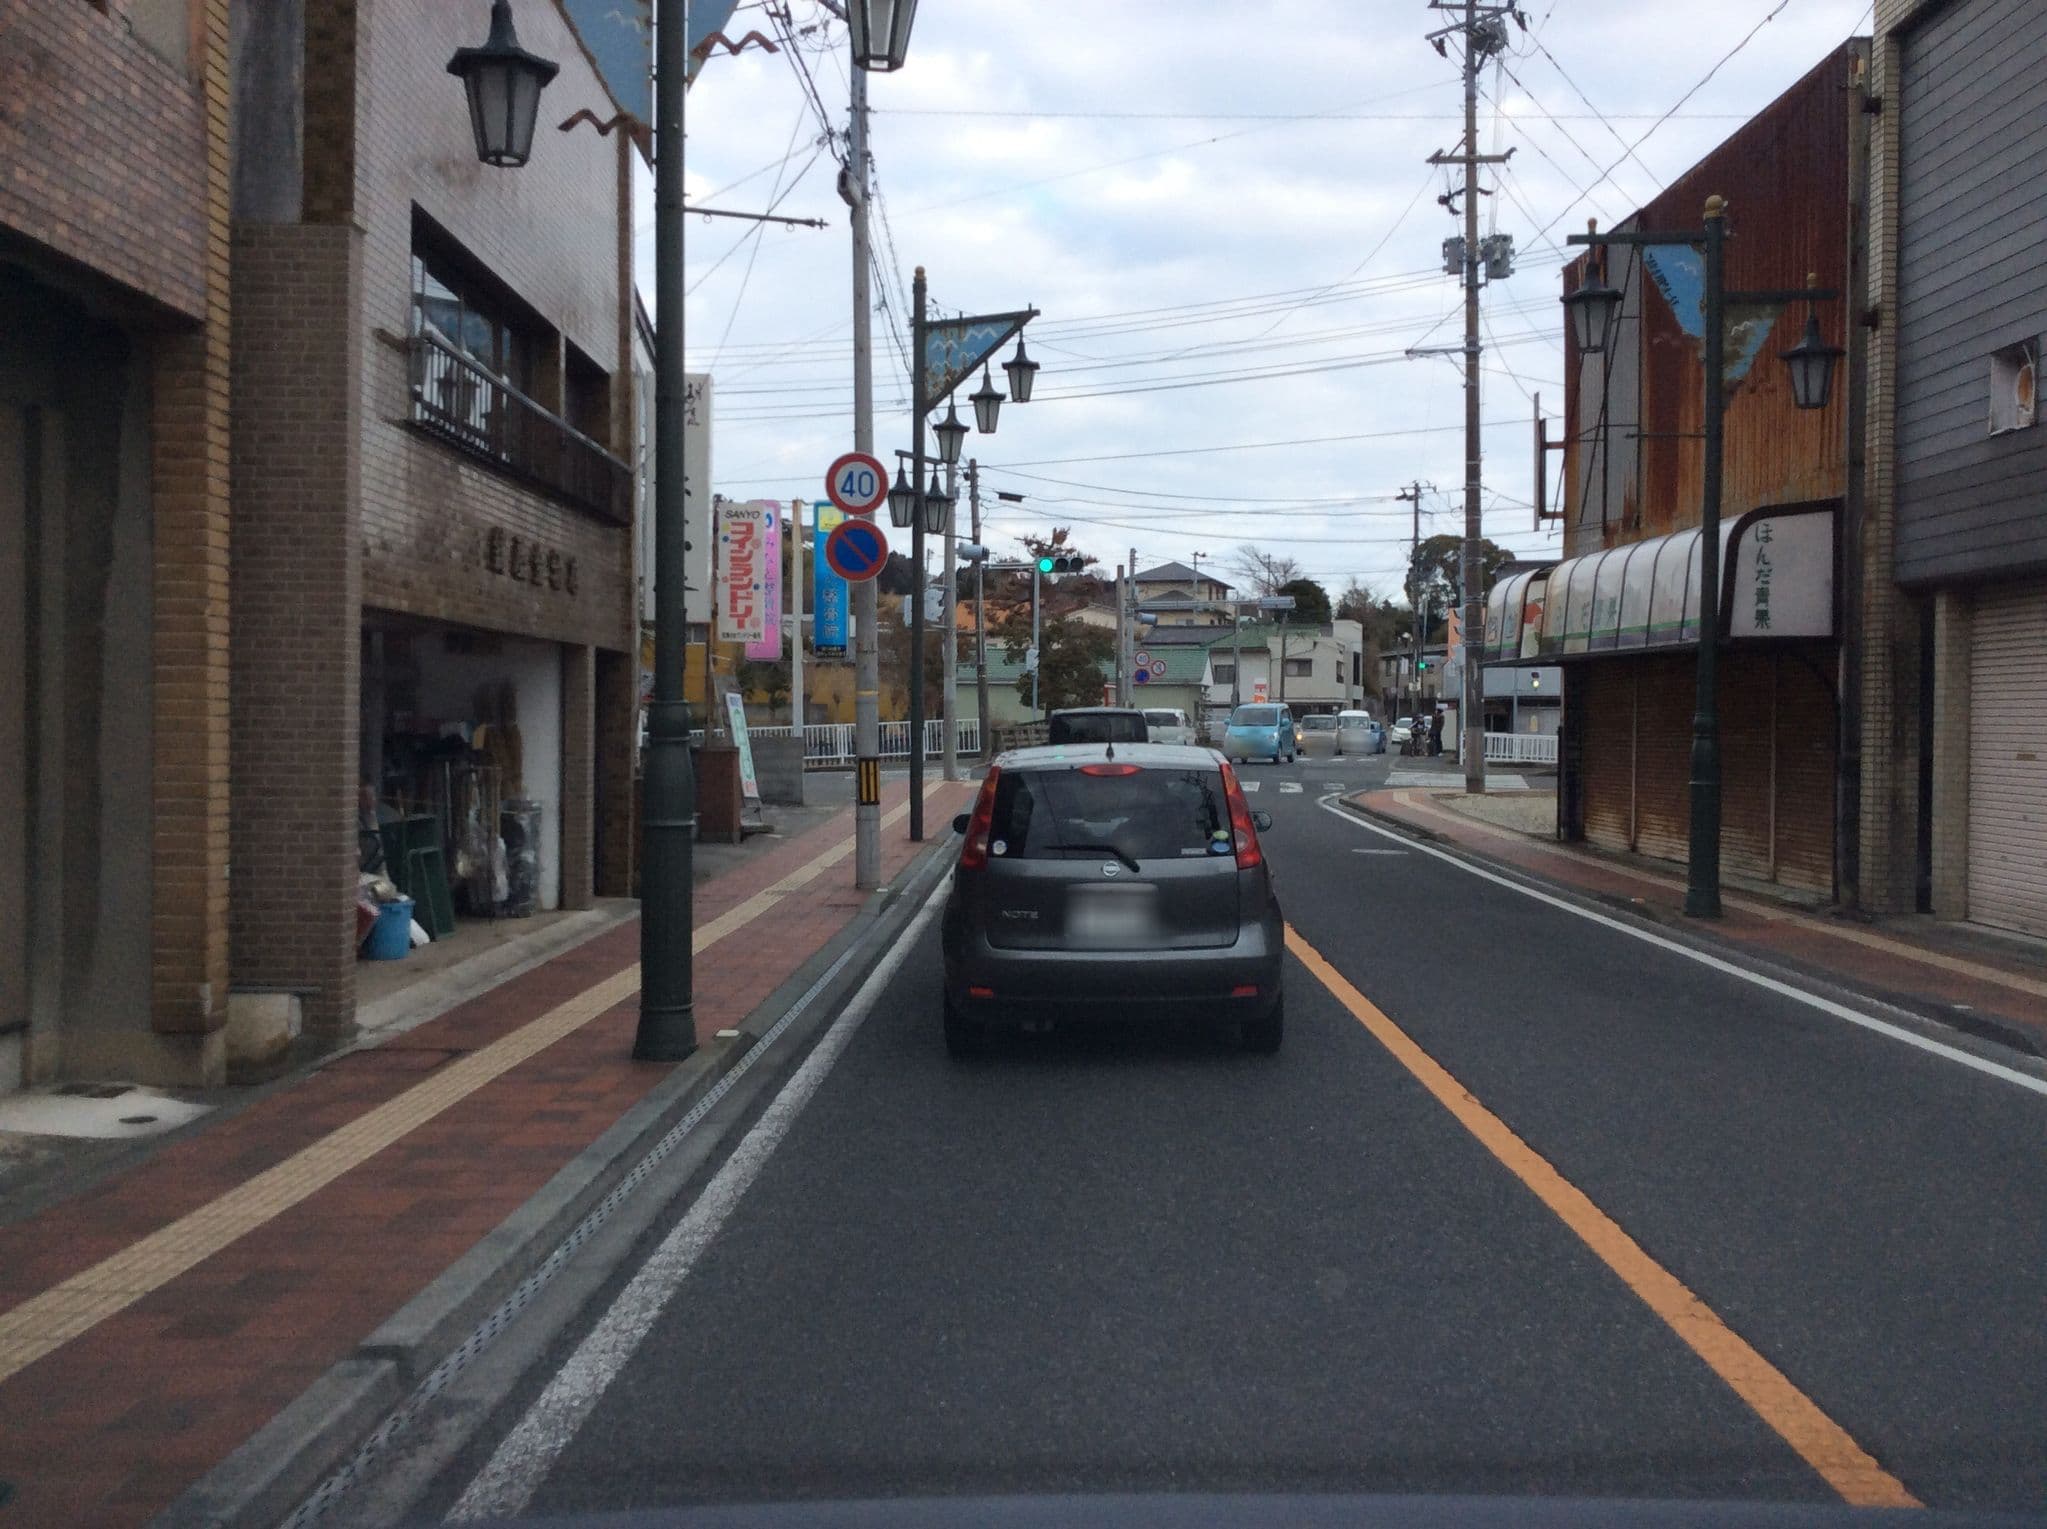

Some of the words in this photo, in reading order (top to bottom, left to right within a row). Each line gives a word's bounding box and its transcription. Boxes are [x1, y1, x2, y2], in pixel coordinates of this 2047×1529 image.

[841, 470, 874, 498] 40
[724, 509, 760, 519] SANYO
[1755, 522, 1773, 630] ほんだ青果
